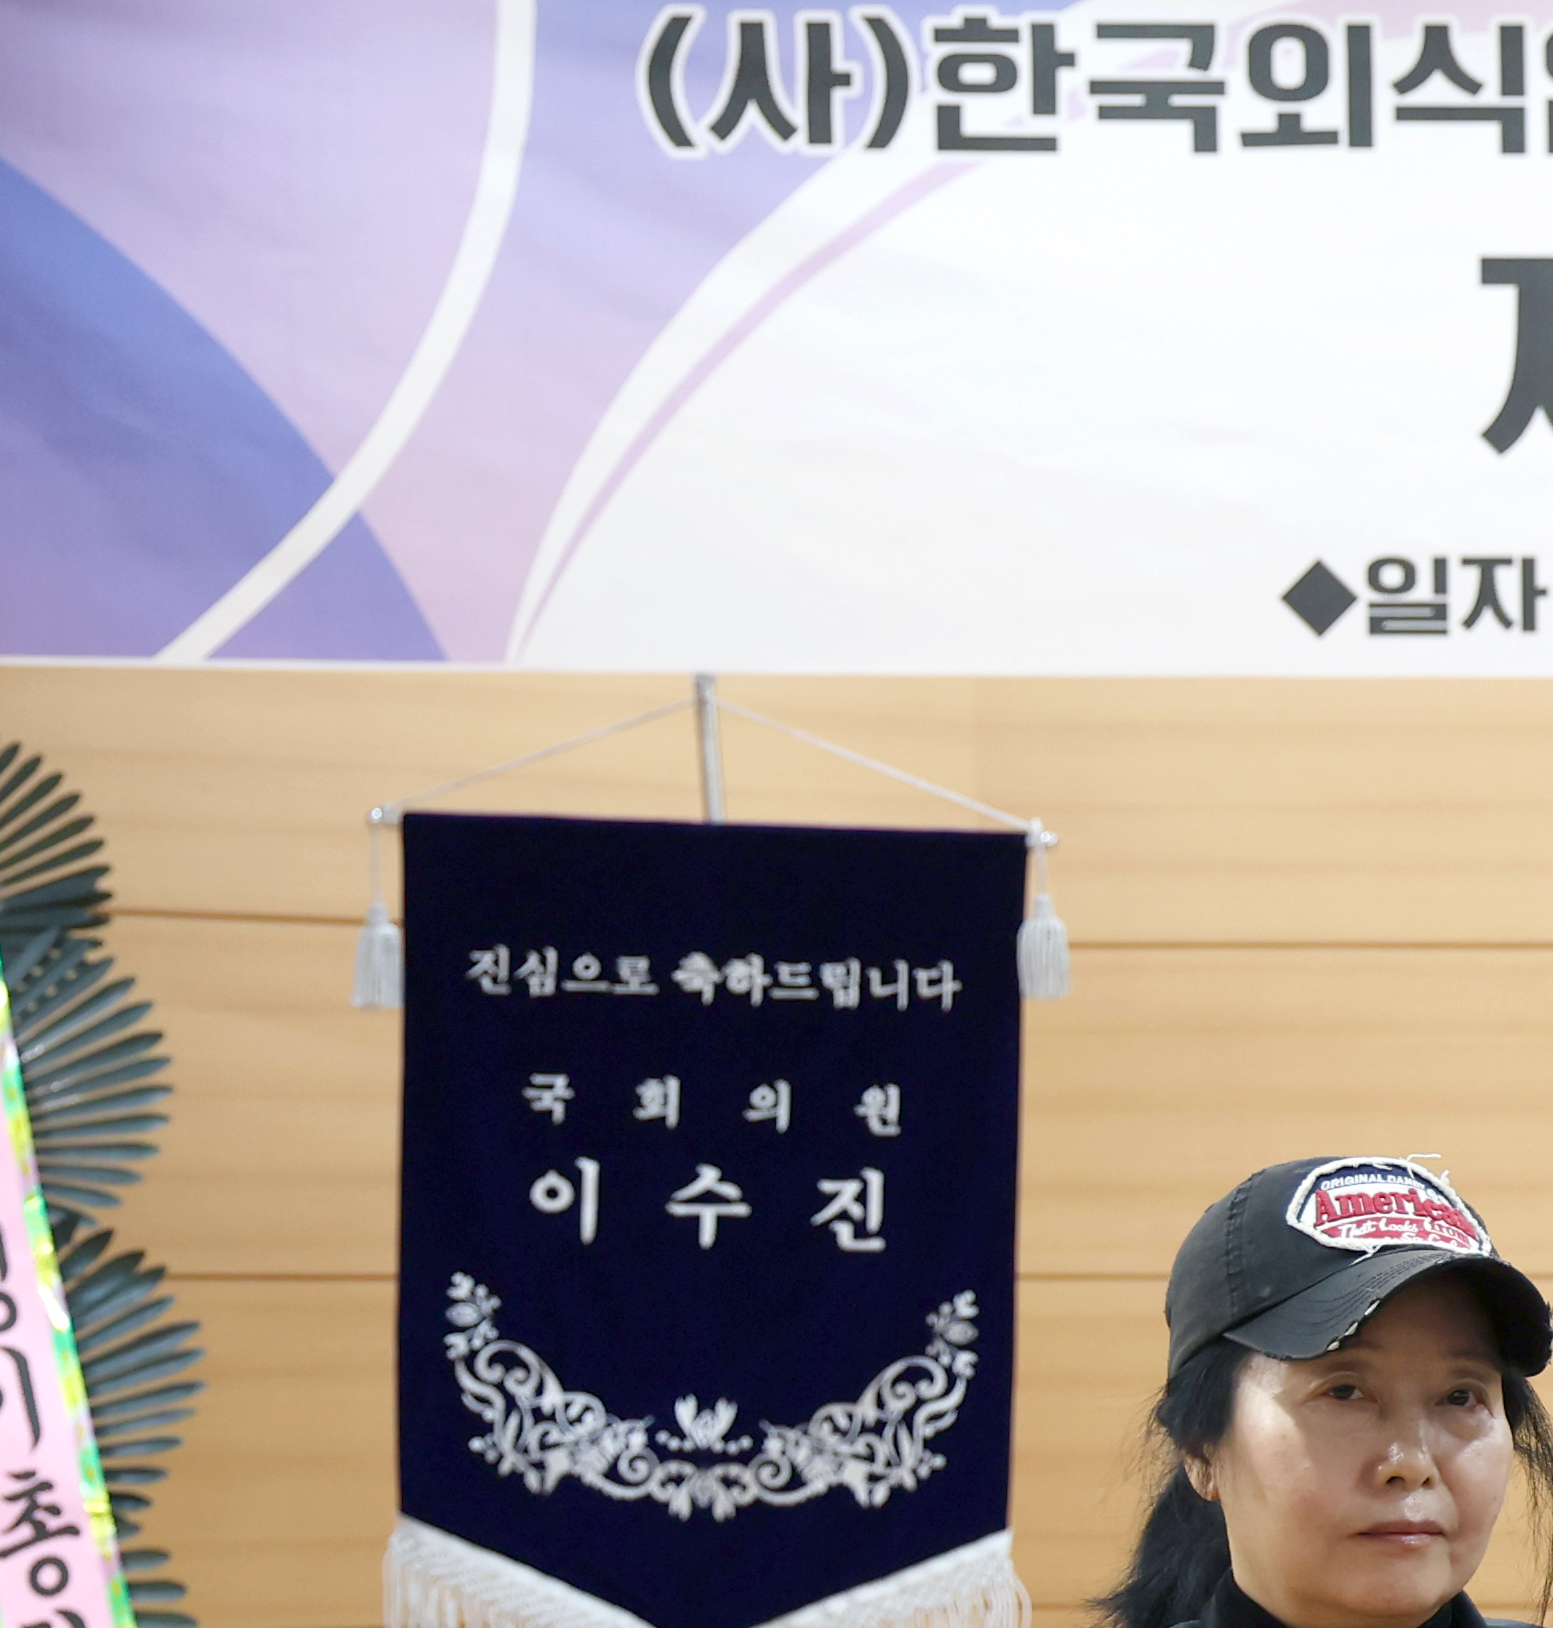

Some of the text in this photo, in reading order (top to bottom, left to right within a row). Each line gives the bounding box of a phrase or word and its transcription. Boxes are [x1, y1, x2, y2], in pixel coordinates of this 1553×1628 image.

[468, 943, 962, 1013] 진심으로 축하드립니다
[1321, 1173, 1385, 1190] ORIGINAL
